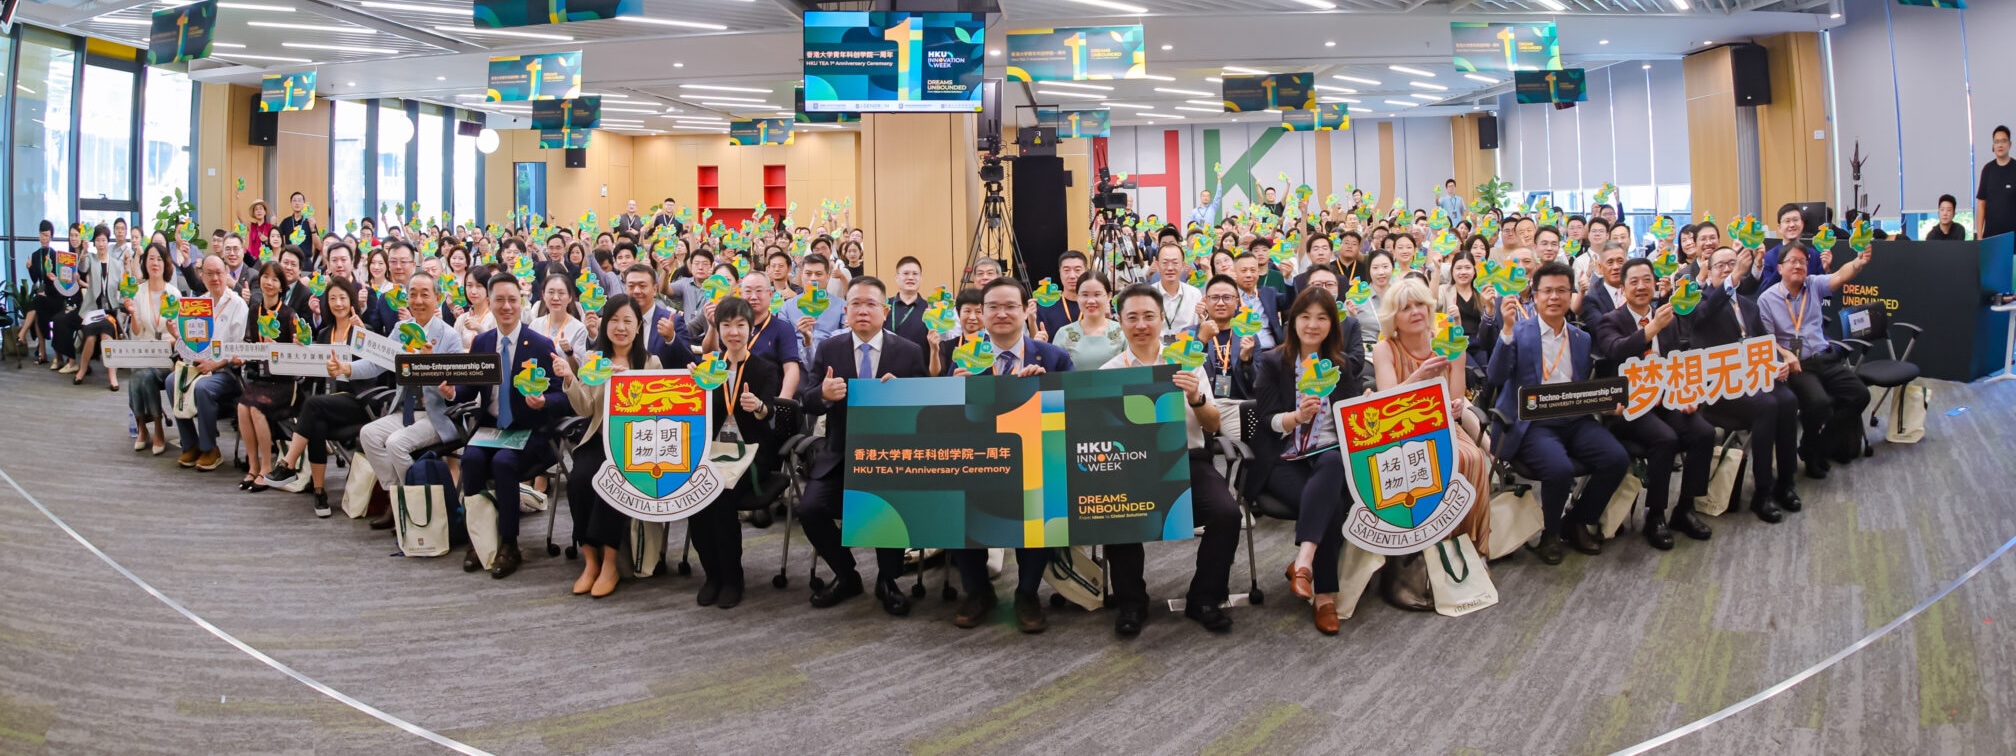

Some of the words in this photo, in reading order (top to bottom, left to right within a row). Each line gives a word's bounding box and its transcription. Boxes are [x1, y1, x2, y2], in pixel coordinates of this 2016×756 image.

[884, 17, 923, 100] 1
[1093, 122, 1396, 232] HKU
[1843, 284, 1879, 296] DREAMS
[411, 362, 480, 371] Techno-Entrepreneurship
[1623, 339, 1777, 416] 梦想无界
[1538, 388, 1609, 402] Techno-Entrepreneurship
[854, 447, 1011, 461] 香港大学青年科创学院一周年
[1076, 441, 1112, 454] HKU
[1076, 451, 1147, 463] INNOVATION
[853, 466, 873, 474] HKU
[875, 466, 894, 474] TEA
[905, 466, 960, 475] Anniversary
[962, 465, 1011, 474] Ceremony
[996, 390, 1069, 548] 1
[1087, 462, 1122, 472] WEEK
[602, 478, 651, 512] SAPIENTIA
[657, 501, 670, 513] ET
[674, 479, 713, 509] VIRTUS
[1078, 493, 1127, 505] DREAMS
[1078, 502, 1155, 514] UNBOUNDED
[1353, 523, 1409, 546] SAPIENTIA
[1415, 528, 1427, 541] ET
[1431, 494, 1466, 532] VIRTUS
